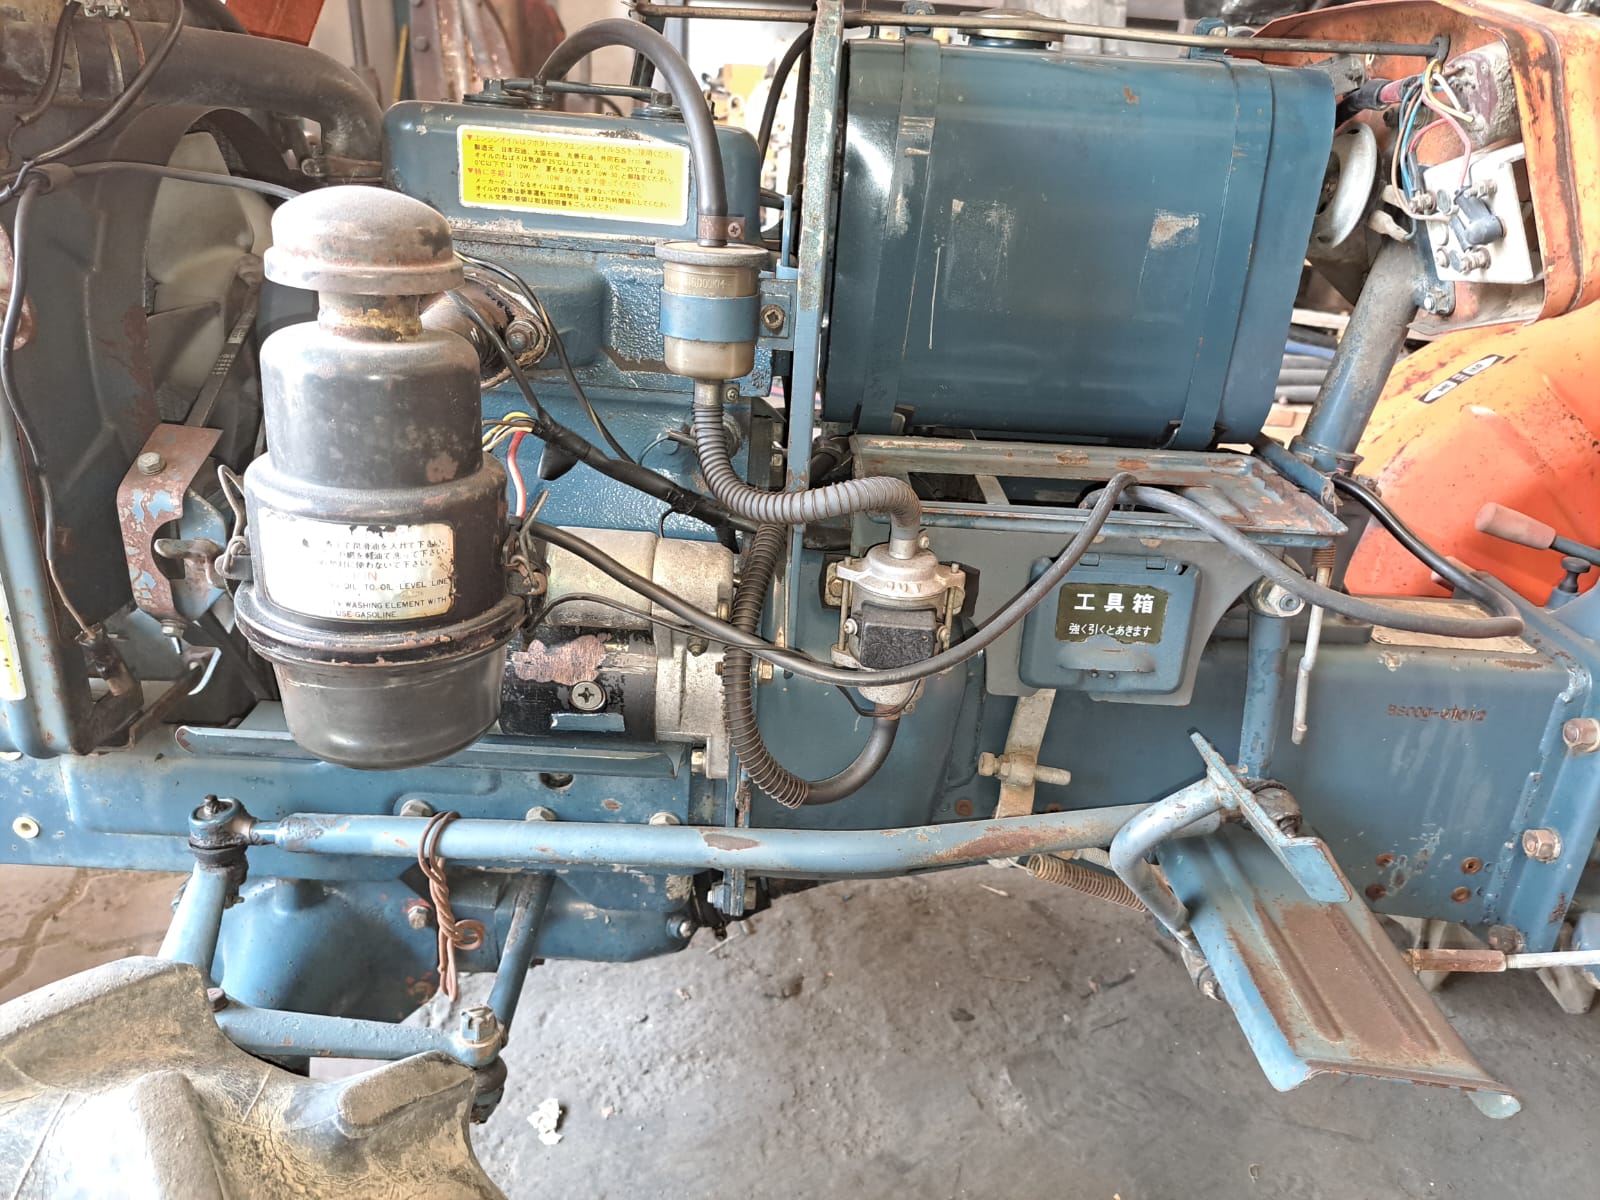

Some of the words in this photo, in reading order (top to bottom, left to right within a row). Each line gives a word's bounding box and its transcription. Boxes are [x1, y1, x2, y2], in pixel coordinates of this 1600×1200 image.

[380, 583, 393, 591] OIL
[399, 580, 427, 590] LEVEL
[432, 577, 449, 588] LINE
[345, 600, 383, 610] WASHING
[385, 599, 425, 609] ELEMENT
[427, 596, 447, 606] WITH
[1073, 592, 1155, 614] 工具箱
[336, 610, 352, 618] USE
[355, 610, 398, 619] GASOLINE
[1068, 622, 1152, 637] 強く引くとあきます
